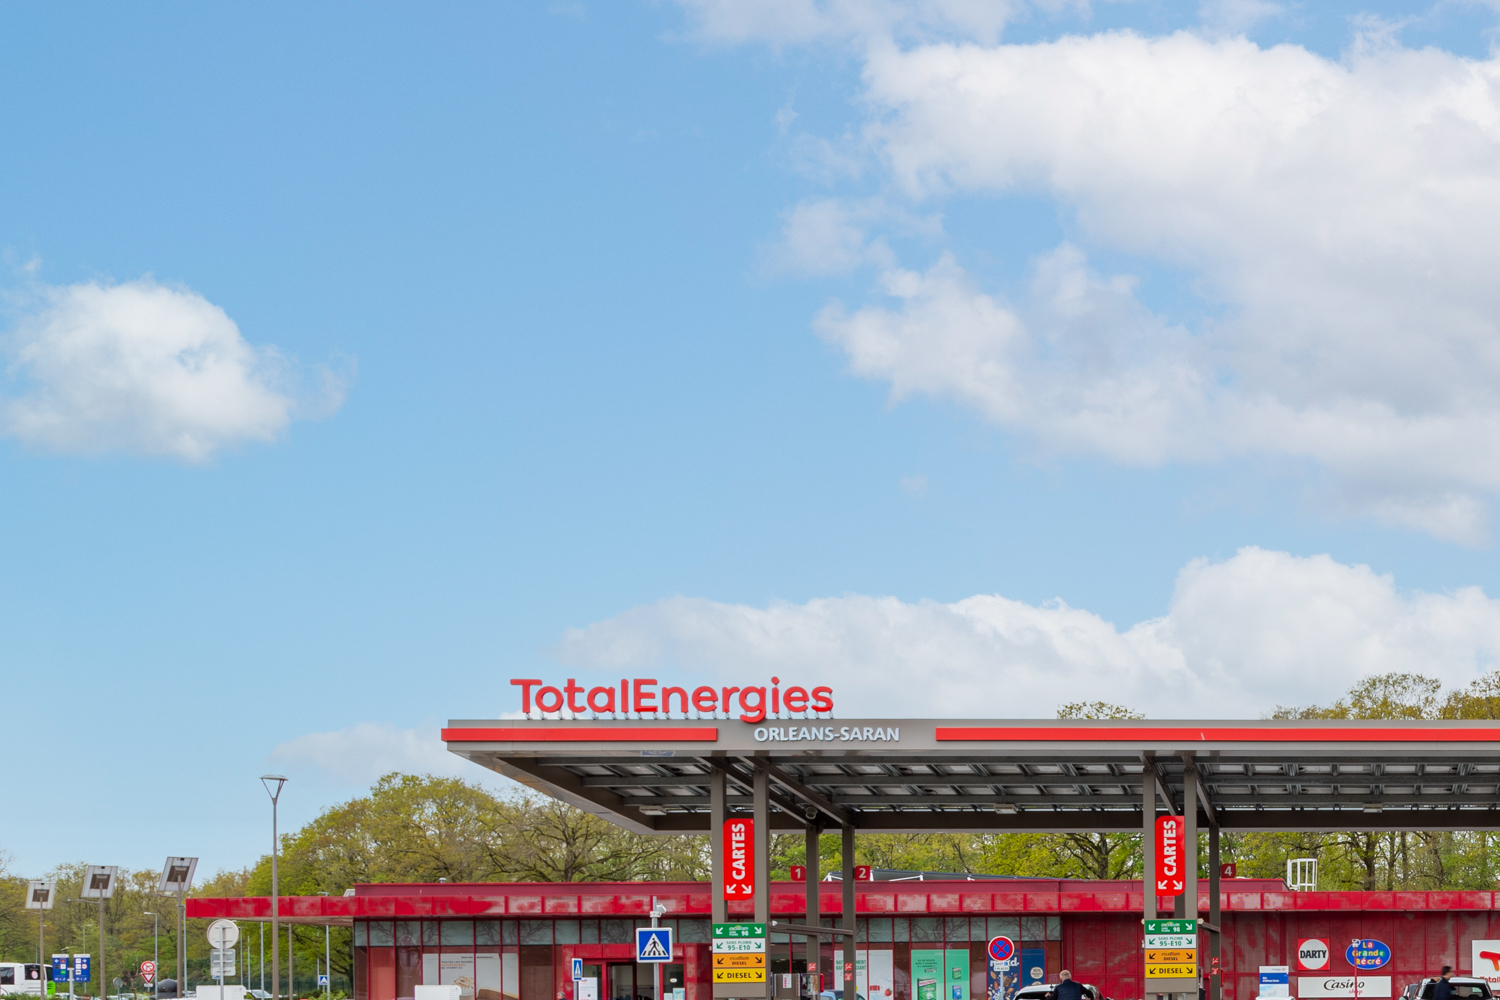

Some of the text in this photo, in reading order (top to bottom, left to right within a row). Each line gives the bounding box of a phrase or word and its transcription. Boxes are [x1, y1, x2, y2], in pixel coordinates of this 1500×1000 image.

[510, 676, 834, 723] TotalEnergies
[754, 727, 900, 742] ORLEANS-SARAN
[732, 823, 746, 880] CARTES
[1163, 820, 1177, 876] CARTES
[795, 868, 801, 879] 1
[859, 868, 867, 878] 2
[1224, 866, 1232, 876] 4
[1300, 950, 1327, 958] DARTY
